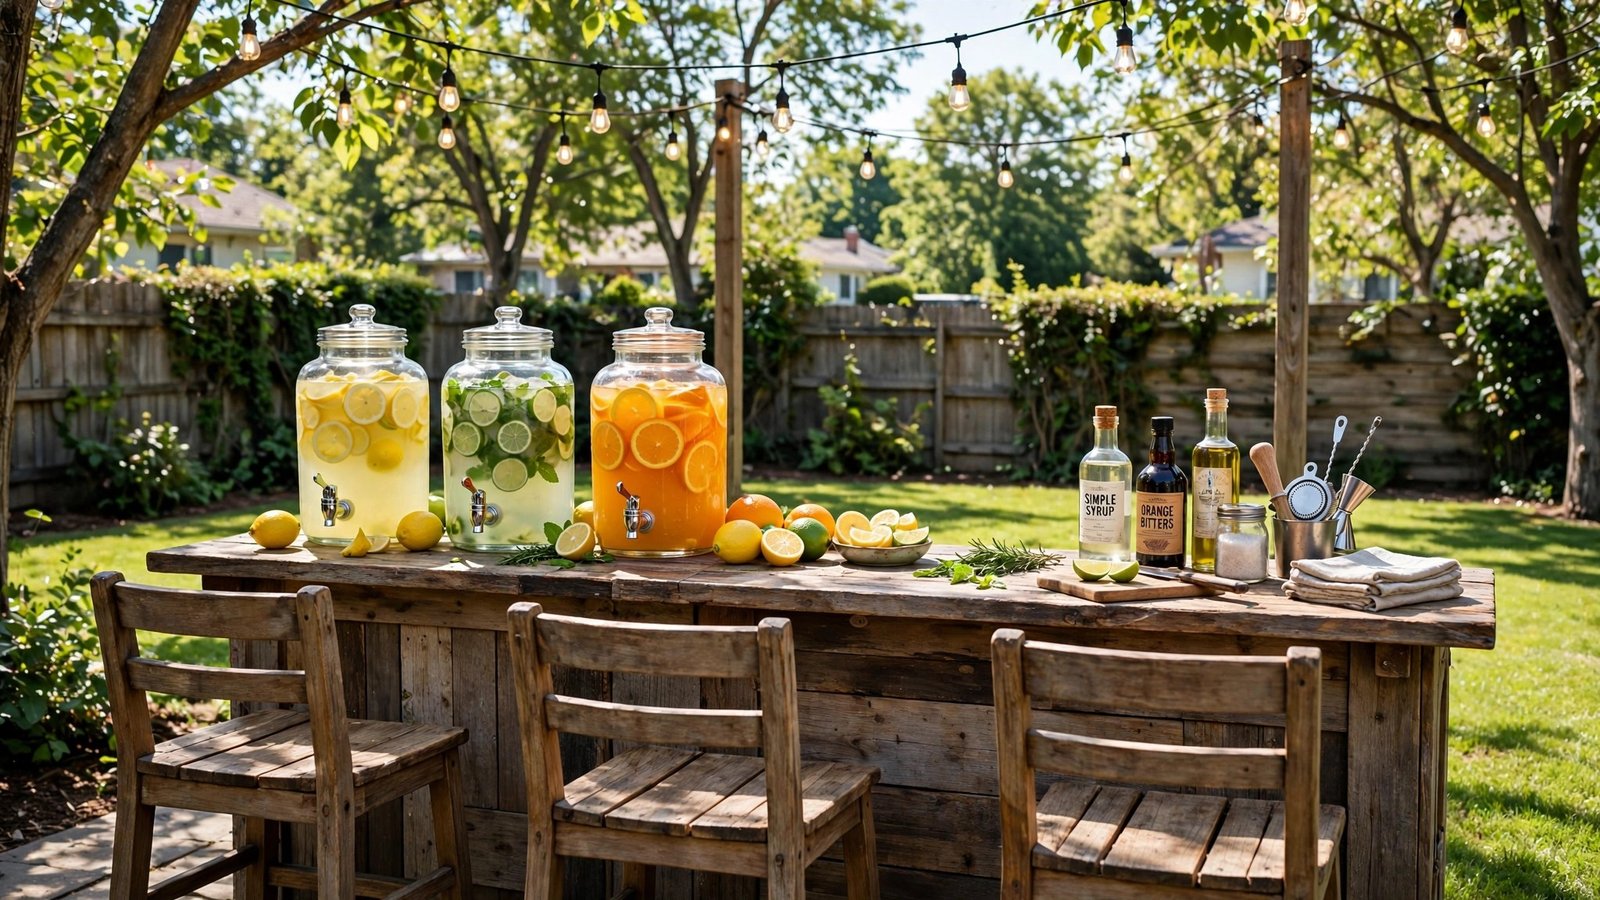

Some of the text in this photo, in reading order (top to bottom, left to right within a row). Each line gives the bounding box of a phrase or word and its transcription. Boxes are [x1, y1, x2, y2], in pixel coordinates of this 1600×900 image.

[1085, 493, 1116, 505] SIMPLE
[1086, 505, 1115, 517] SYRUP
[1141, 504, 1174, 517] ORANGE
[1141, 517, 1174, 529] BITTERS
